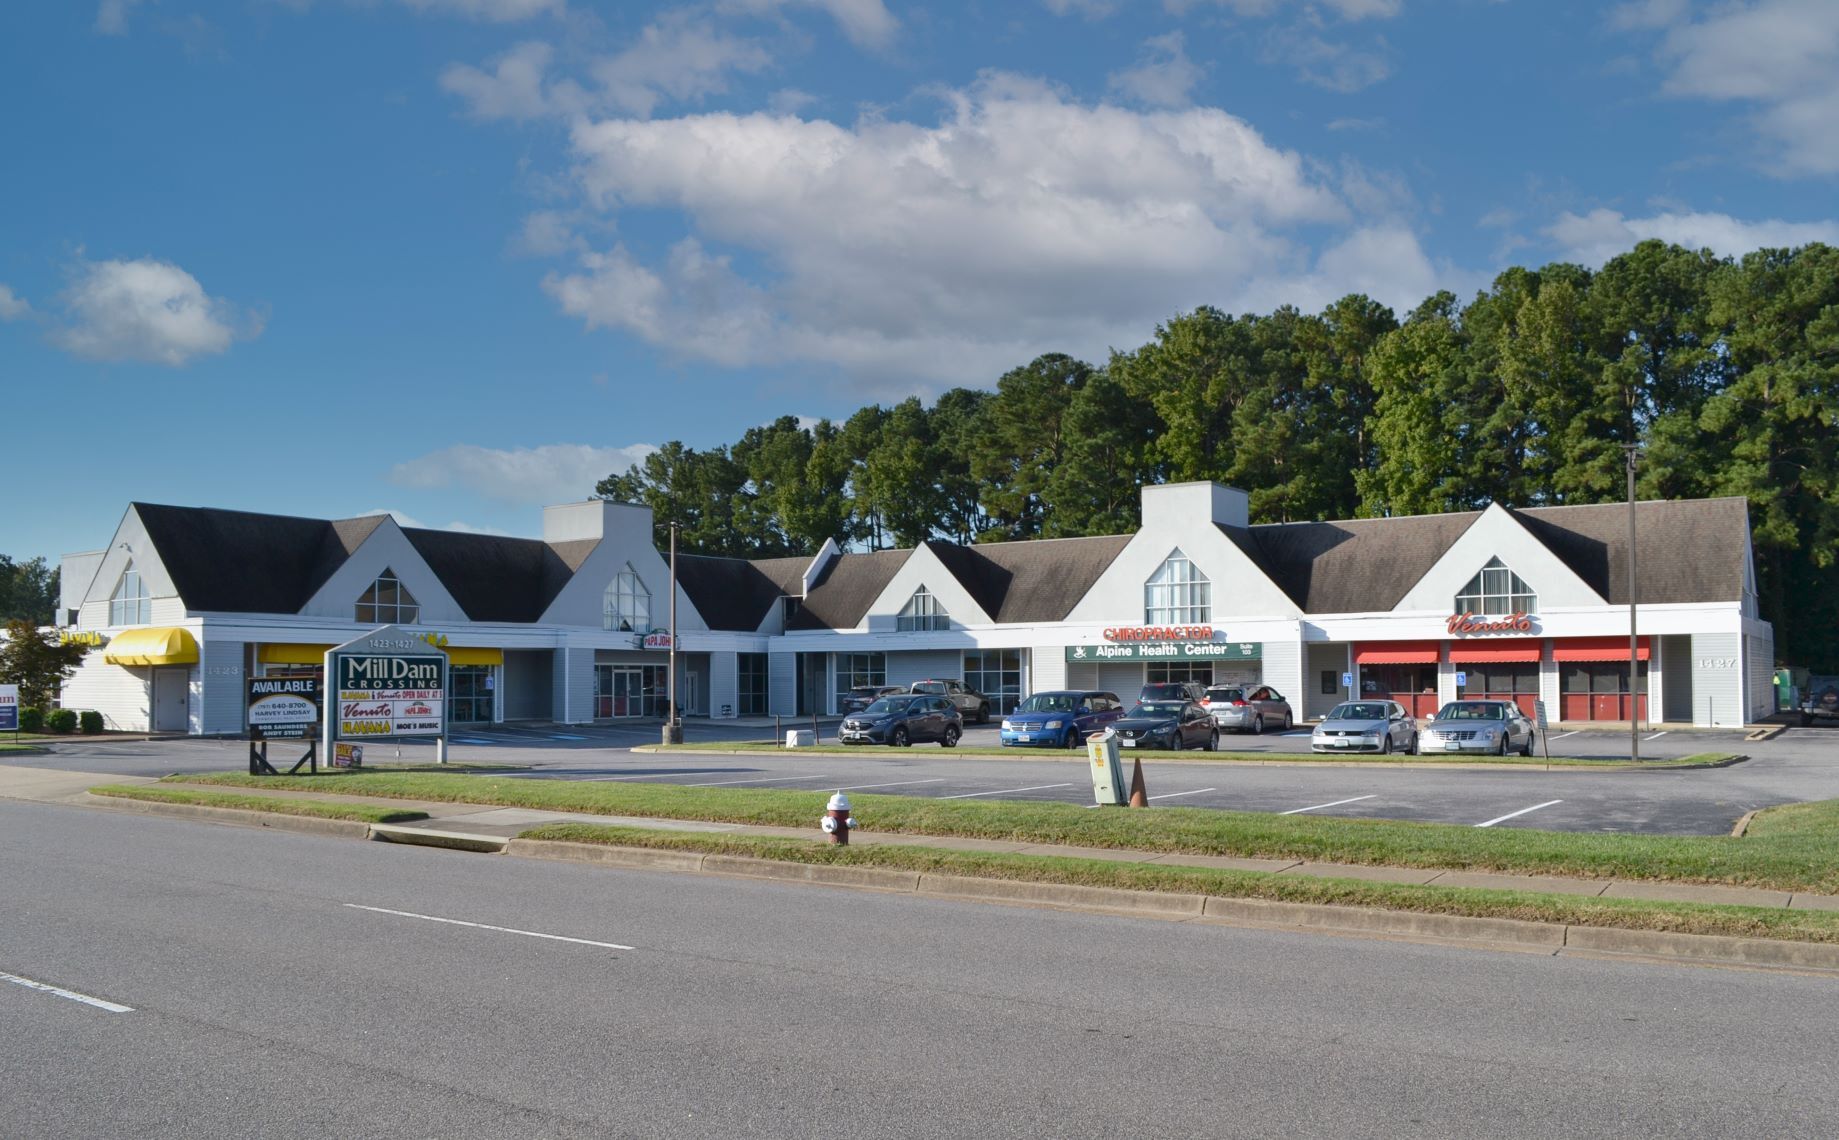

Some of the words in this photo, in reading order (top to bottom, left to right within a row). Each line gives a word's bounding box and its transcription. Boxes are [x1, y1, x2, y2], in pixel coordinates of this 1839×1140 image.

[1445, 610, 1531, 634] Venuto
[1103, 626, 1213, 641] CHIROPRACTOR
[369, 639, 414, 649] 1423-1427
[644, 635, 658, 647] PAPA
[1096, 645, 1133, 658] Alpine
[1139, 644, 1178, 656] Health
[1184, 644, 1227, 655] Center
[347, 658, 389, 679] Mill
[392, 658, 438, 679] Dam
[252, 680, 314, 693] AVAILABLE
[347, 680, 438, 689] CROSSING
[376, 690, 401, 699] Venuto
[402, 691, 416, 699] OPEN
[416, 690, 430, 698] DAILY
[343, 702, 391, 718] Venuto
[342, 720, 391, 734] HAVANA
